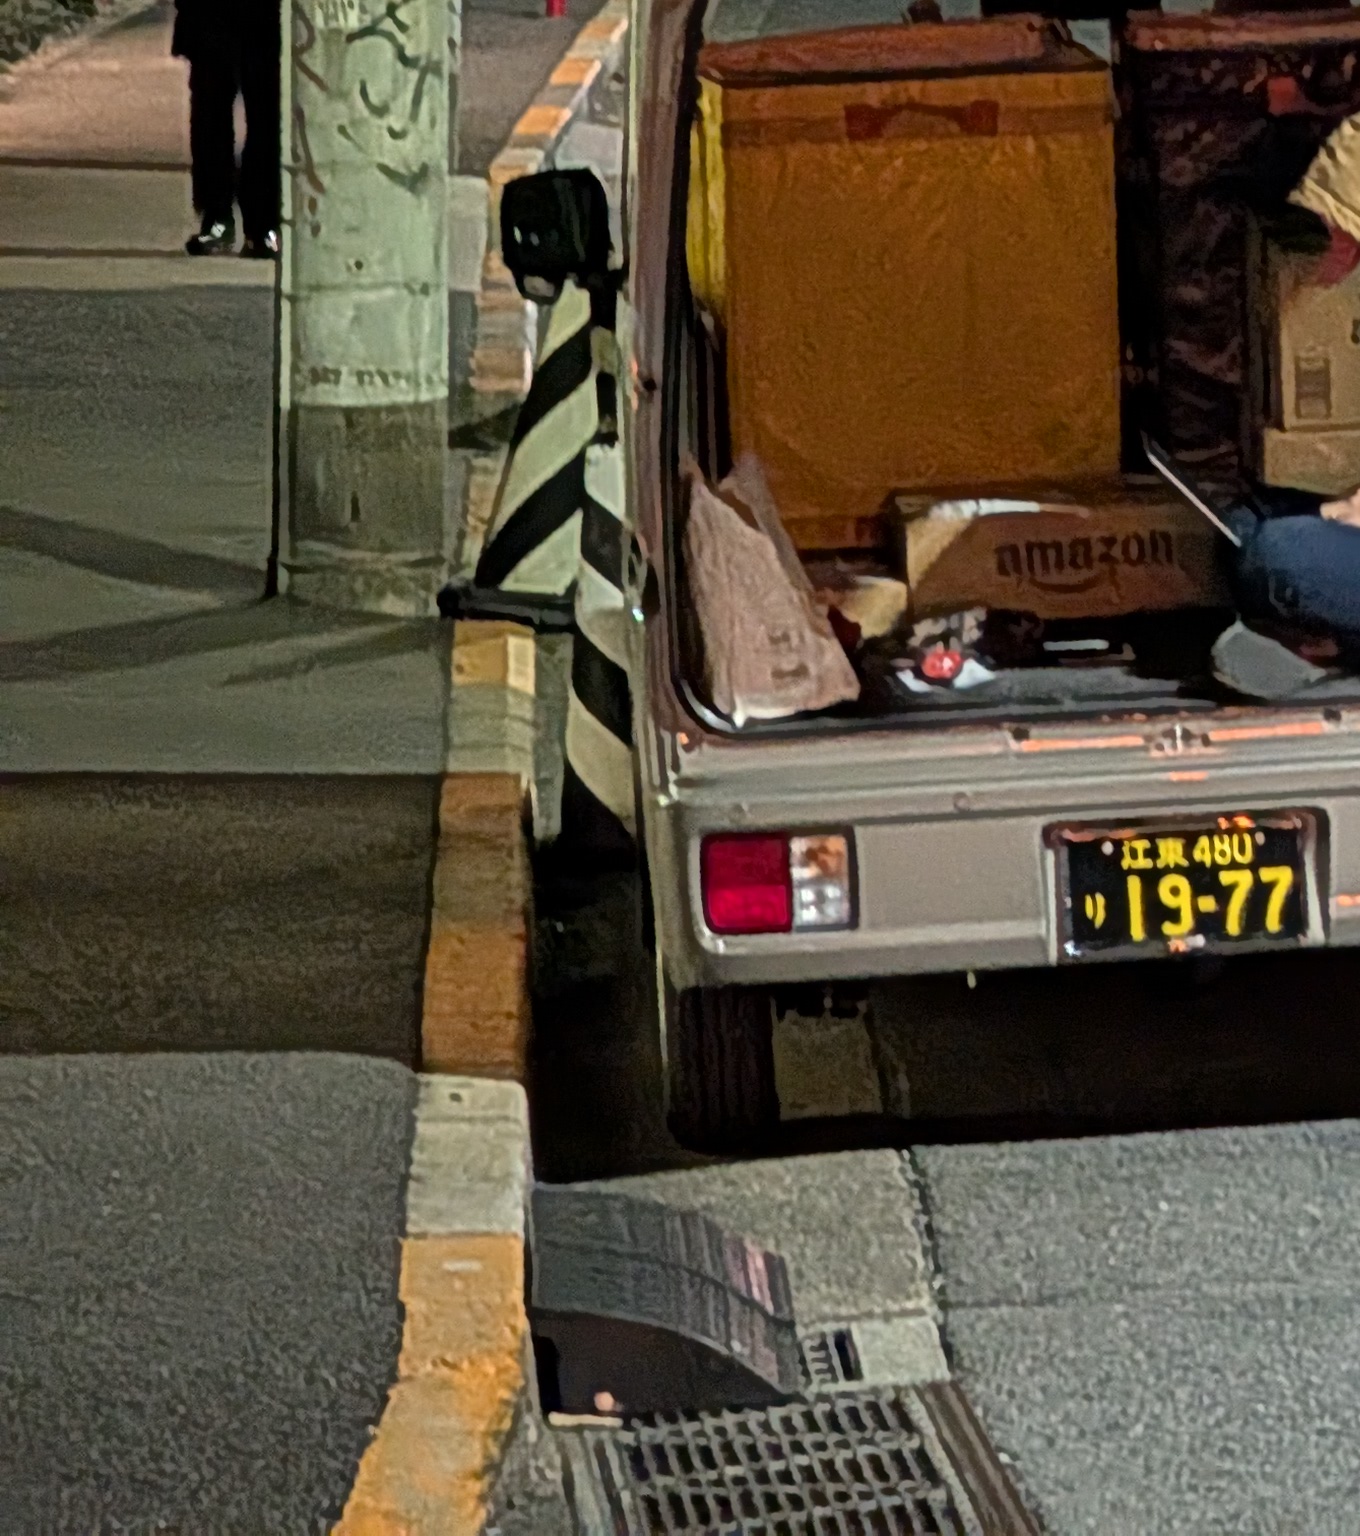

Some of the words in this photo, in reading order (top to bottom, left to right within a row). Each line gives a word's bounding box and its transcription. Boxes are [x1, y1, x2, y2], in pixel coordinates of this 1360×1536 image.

[994, 528, 1174, 578] amazon
[1120, 838, 1190, 870] 江東
[1192, 832, 1254, 868] 480
[1084, 891, 1107, 930] り
[1126, 865, 1294, 942] 19-77
